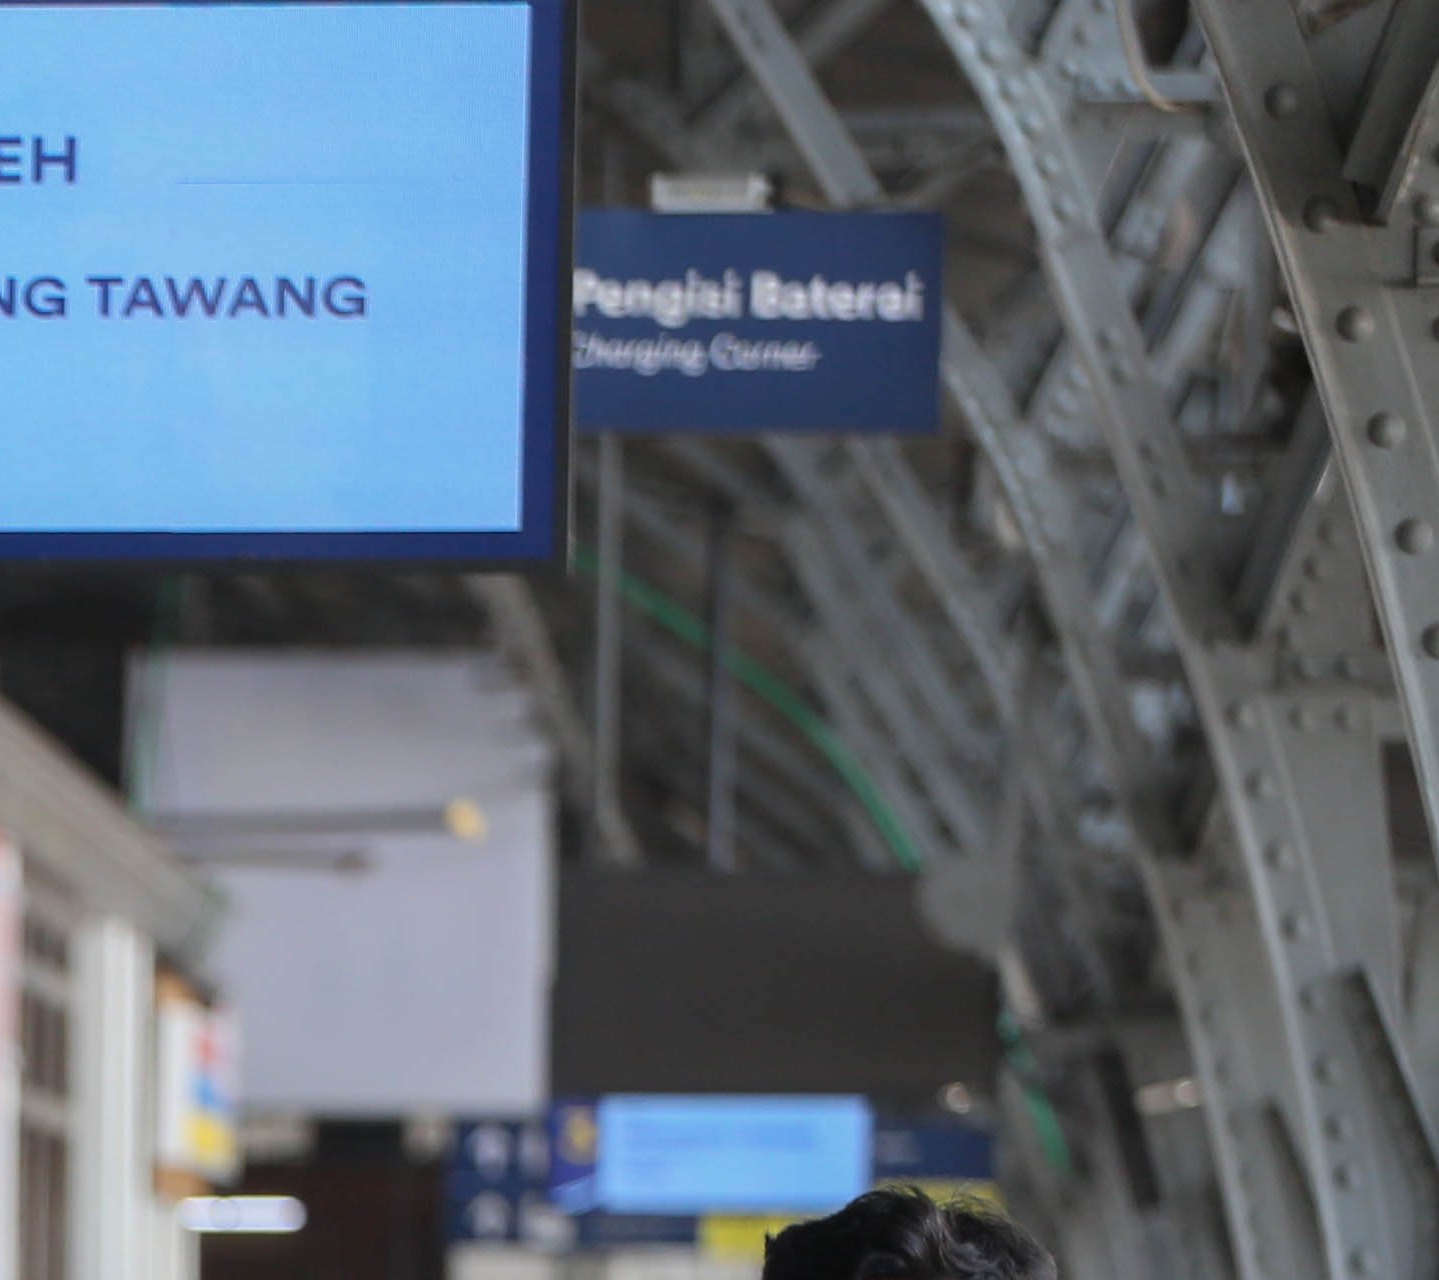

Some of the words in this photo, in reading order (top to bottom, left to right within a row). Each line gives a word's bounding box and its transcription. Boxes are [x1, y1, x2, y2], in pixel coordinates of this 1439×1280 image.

[85, 275, 369, 319] TAWANG
[573, 267, 742, 327] Pengisi
[750, 269, 925, 322] Baterai
